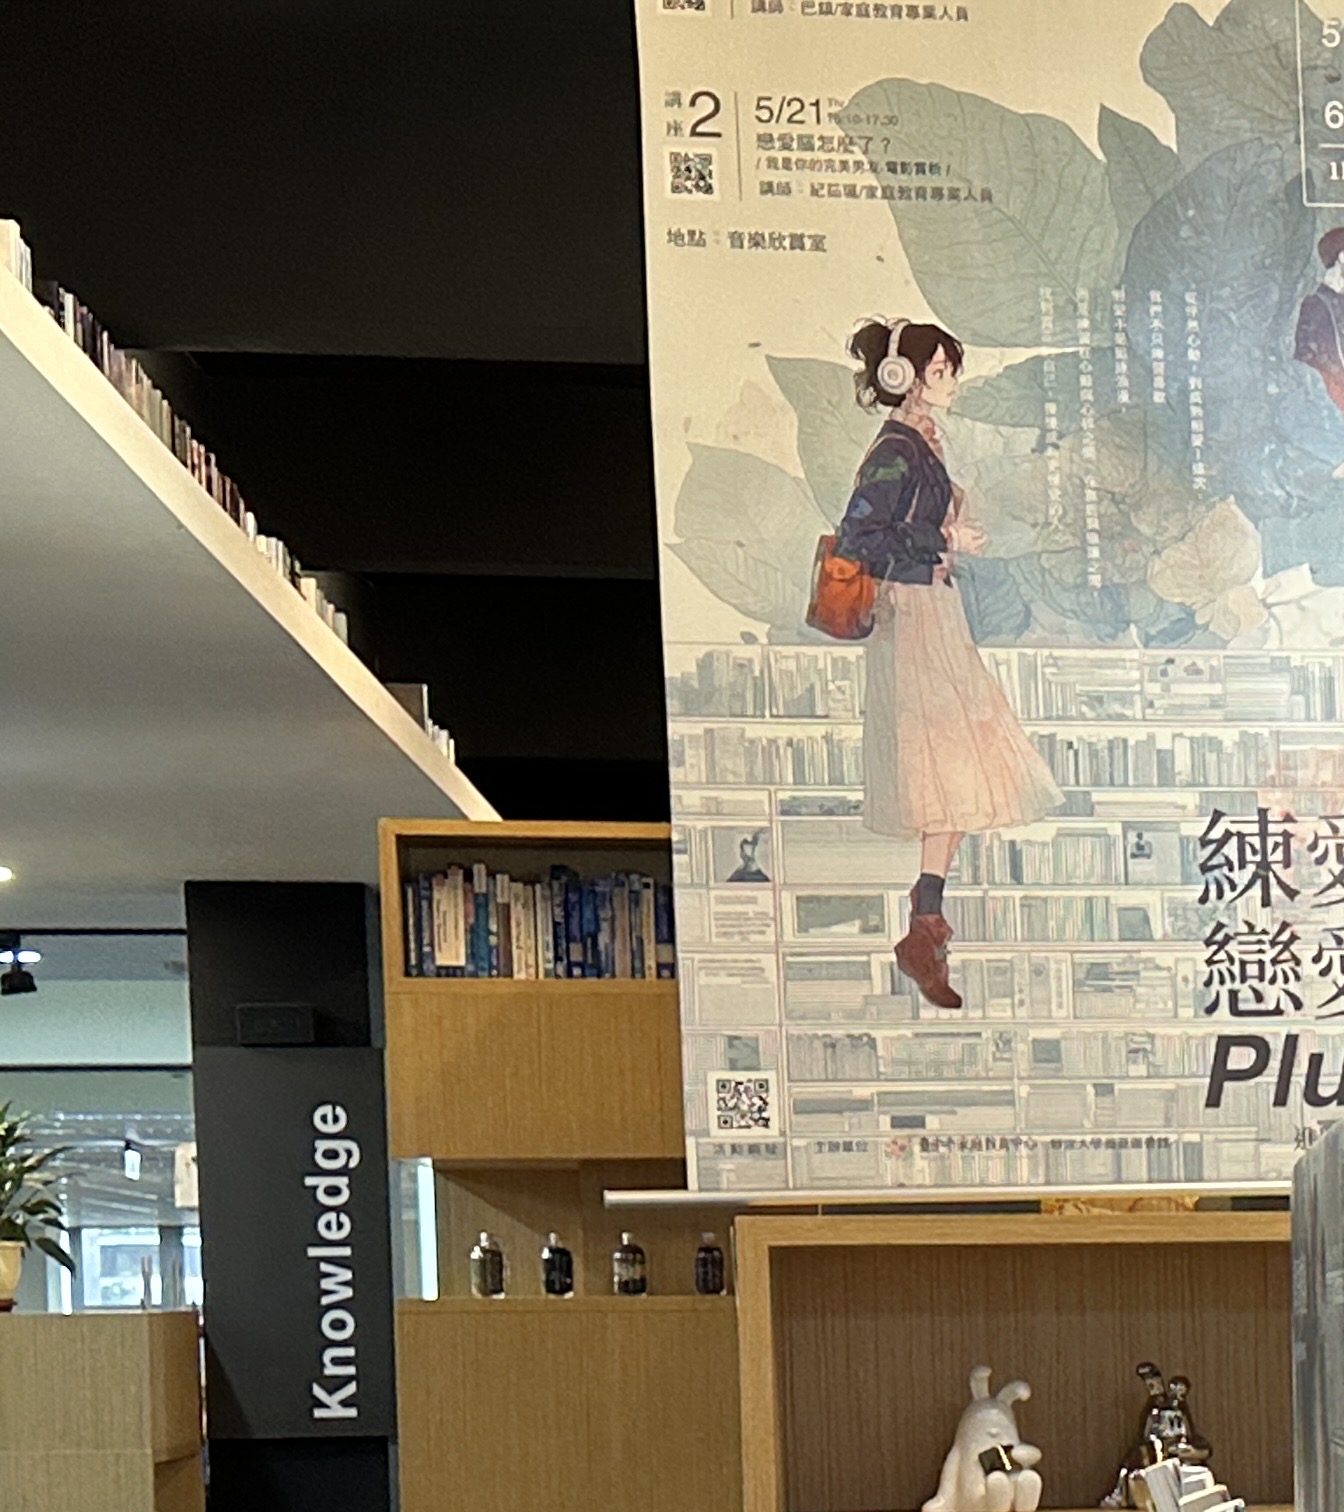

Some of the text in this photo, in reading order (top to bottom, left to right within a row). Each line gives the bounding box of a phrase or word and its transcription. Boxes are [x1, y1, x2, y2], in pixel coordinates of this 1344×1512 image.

[688, 91, 722, 138] 2
[754, 96, 823, 125] 5/21
[304, 1103, 361, 1419] Knowledge
